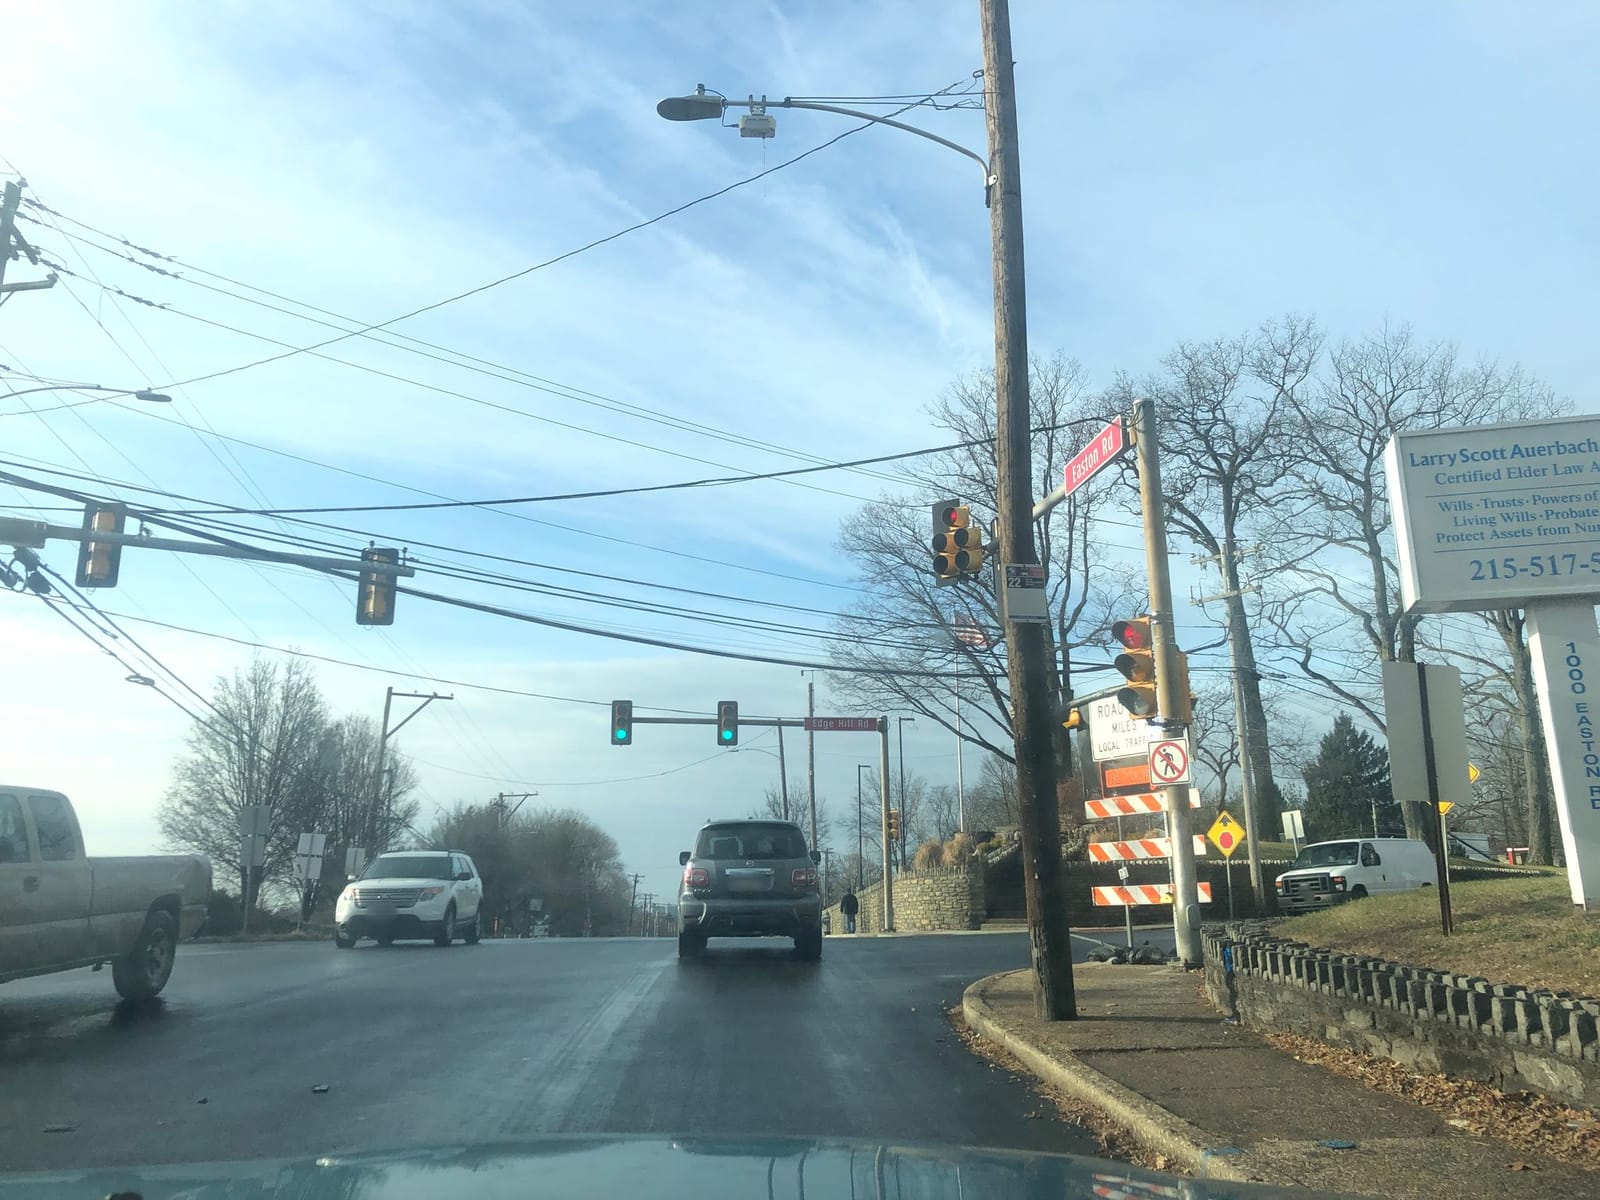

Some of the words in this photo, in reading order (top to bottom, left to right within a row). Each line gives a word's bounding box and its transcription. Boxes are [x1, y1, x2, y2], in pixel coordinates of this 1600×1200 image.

[1072, 448, 1099, 483] Easton
[1102, 429, 1114, 457] Rd
[1409, 452, 1457, 468] Larry
[1461, 446, 1506, 464] Scott
[1510, 437, 1599, 460] Auerbach
[1434, 468, 1501, 486] Certified
[1507, 464, 1548, 480] Elder
[1553, 461, 1585, 476] Law
[1438, 500, 1474, 513] Wills
[1480, 497, 1524, 510] Trusts
[1532, 492, 1582, 506] Powers
[1584, 490, 1600, 502] of
[1453, 514, 1497, 528] Living
[1500, 510, 1537, 524] Wills
[1545, 507, 1599, 521] Probate
[1436, 531, 1485, 544] Protect
[1490, 527, 1533, 540] Assets
[1537, 524, 1570, 537] from
[1470, 551, 1600, 581] 215-517-5
[1007, 576, 1021, 588] 22
[1566, 642, 1586, 694] 1000
[812, 719, 834, 730] Edge
[838, 719, 853, 729] Hill
[858, 719, 869, 729] Rd
[1111, 719, 1137, 734] MILES
[1098, 740, 1121, 753] LOCAL
[1575, 702, 1600, 778] EASTON
